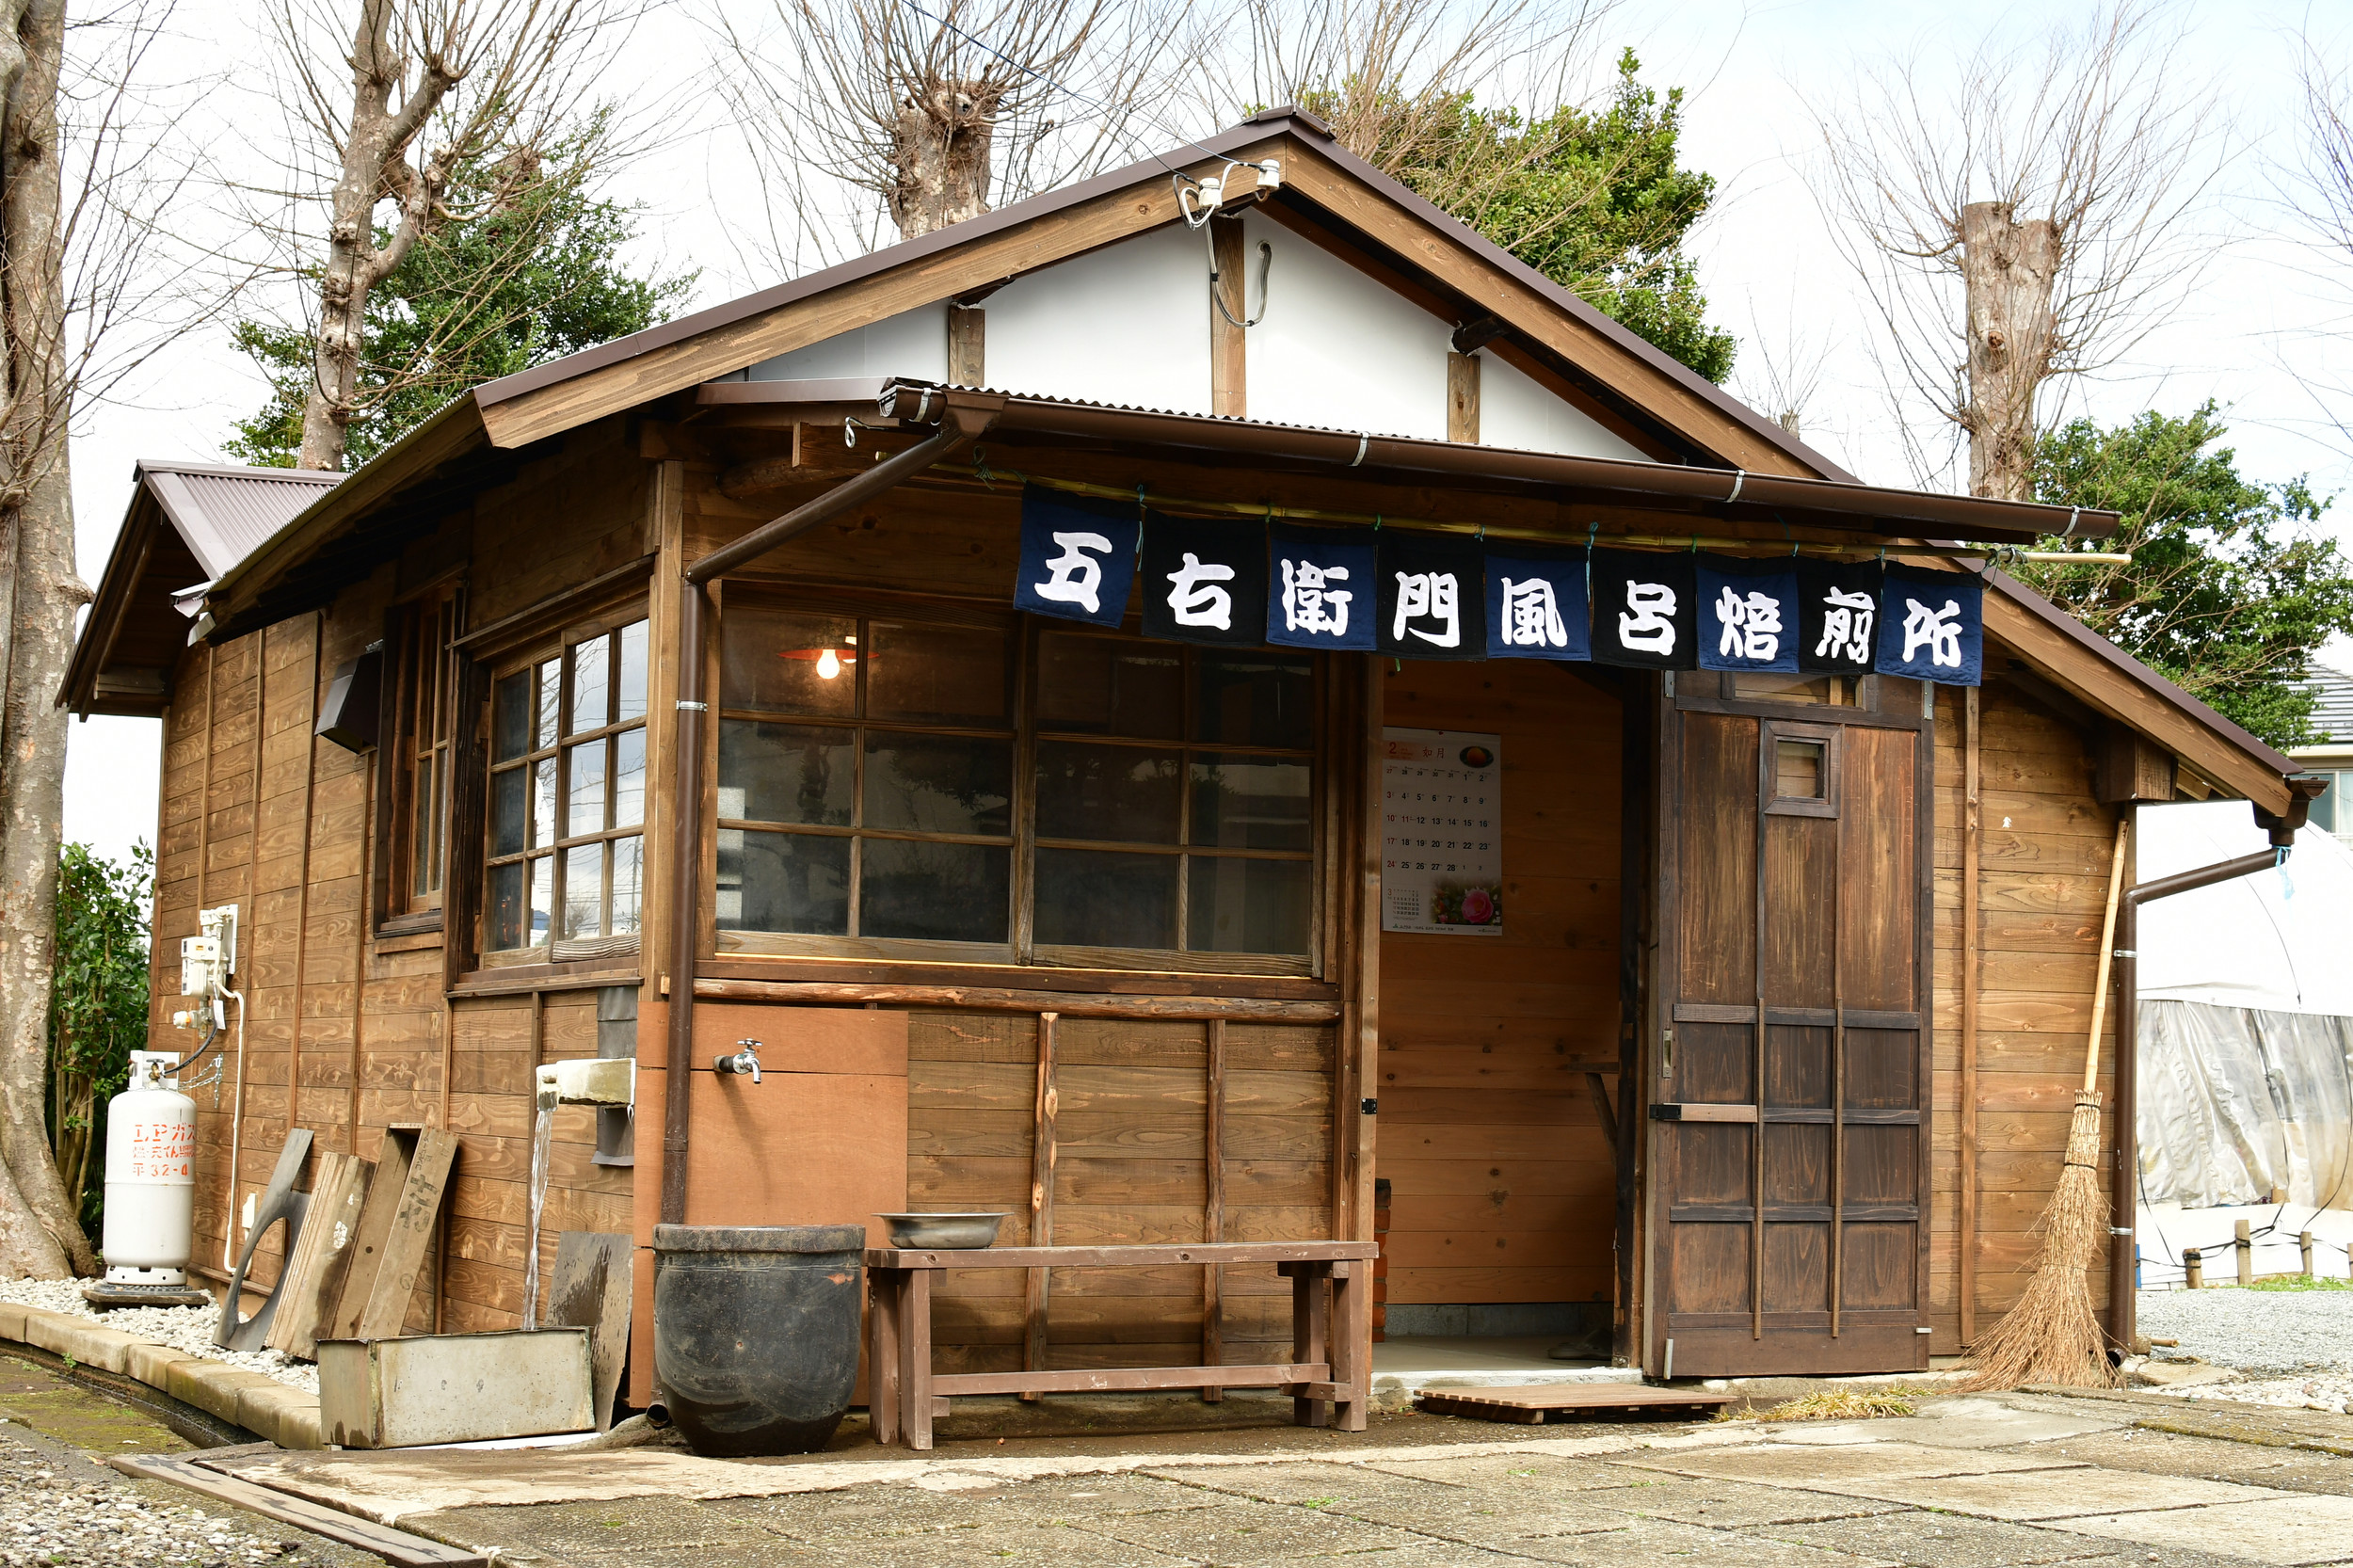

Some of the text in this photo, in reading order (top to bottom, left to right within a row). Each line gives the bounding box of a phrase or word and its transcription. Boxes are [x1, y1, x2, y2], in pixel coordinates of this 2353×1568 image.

[1034, 531, 1962, 666] 五右衛門風呂焙煎所
[1388, 742, 1397, 754] 2
